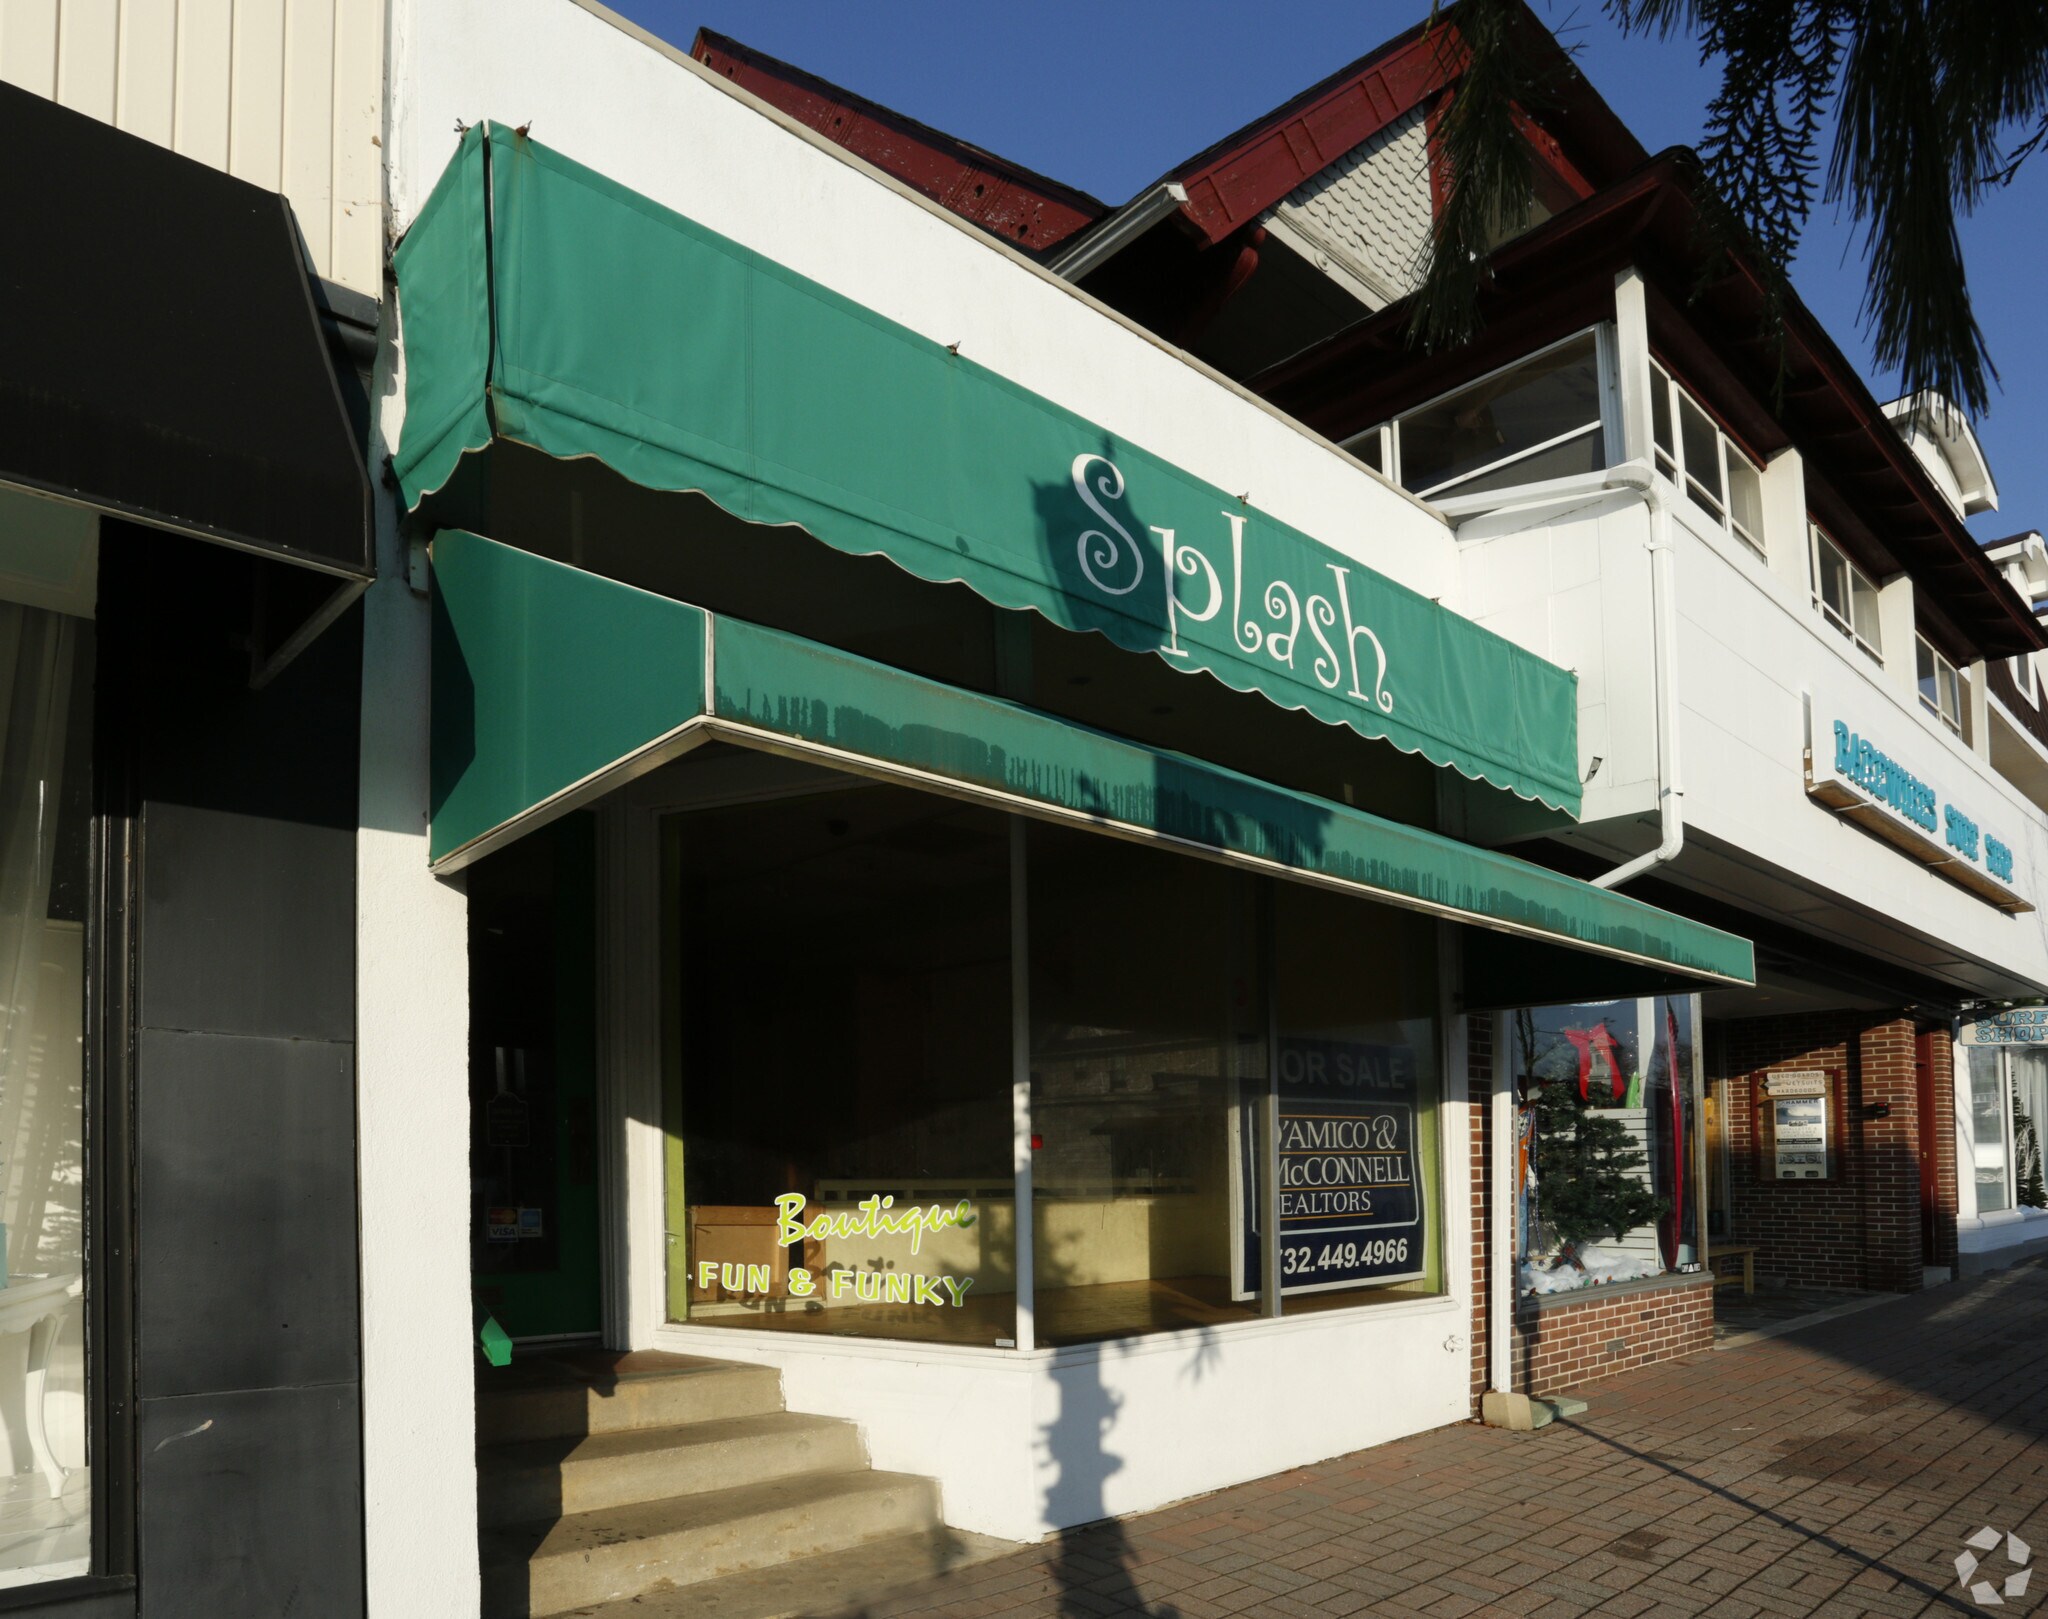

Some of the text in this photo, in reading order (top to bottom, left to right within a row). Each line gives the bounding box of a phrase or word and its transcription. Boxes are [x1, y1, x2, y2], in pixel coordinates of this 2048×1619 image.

[1072, 453, 1393, 714] Splash
[1975, 1011, 2048, 1027] SURF
[1975, 1026, 2048, 1043] SHOP
[1280, 1050, 1406, 1089] OR SALE
[1372, 1114, 1398, 1150] &
[1279, 1190, 1371, 1216] EALTORS
[775, 1192, 977, 1255] Boutique
[1279, 1238, 1408, 1275] 32.449.4966
[698, 1261, 974, 1308] FUN & FUNKY
